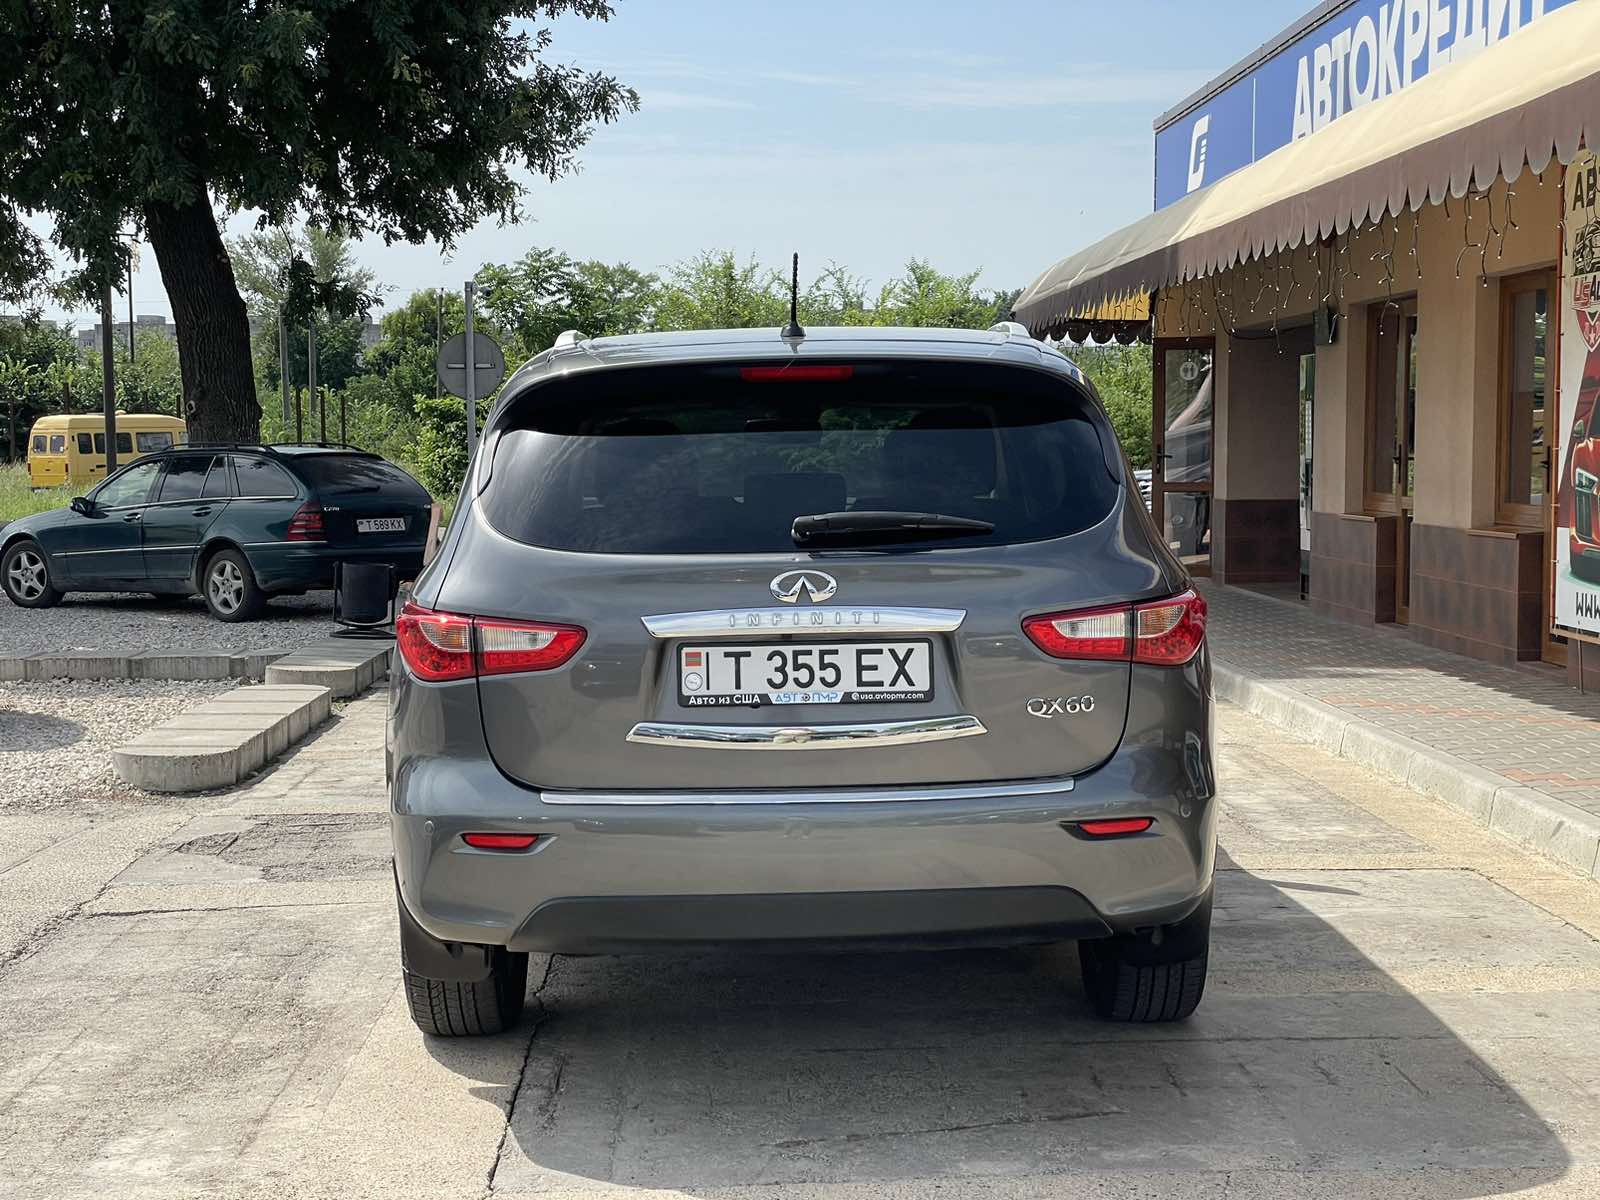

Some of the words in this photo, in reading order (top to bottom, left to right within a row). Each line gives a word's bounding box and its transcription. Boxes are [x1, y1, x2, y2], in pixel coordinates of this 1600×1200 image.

[1291, 0, 1544, 144] АВТОКРЕД
[1572, 167, 1600, 211] АВ
[373, 519, 390, 530] 589
[728, 611, 881, 628] INFINITI
[766, 649, 842, 690] 355
[733, 693, 761, 704] США
[1026, 695, 1096, 719] QX60
